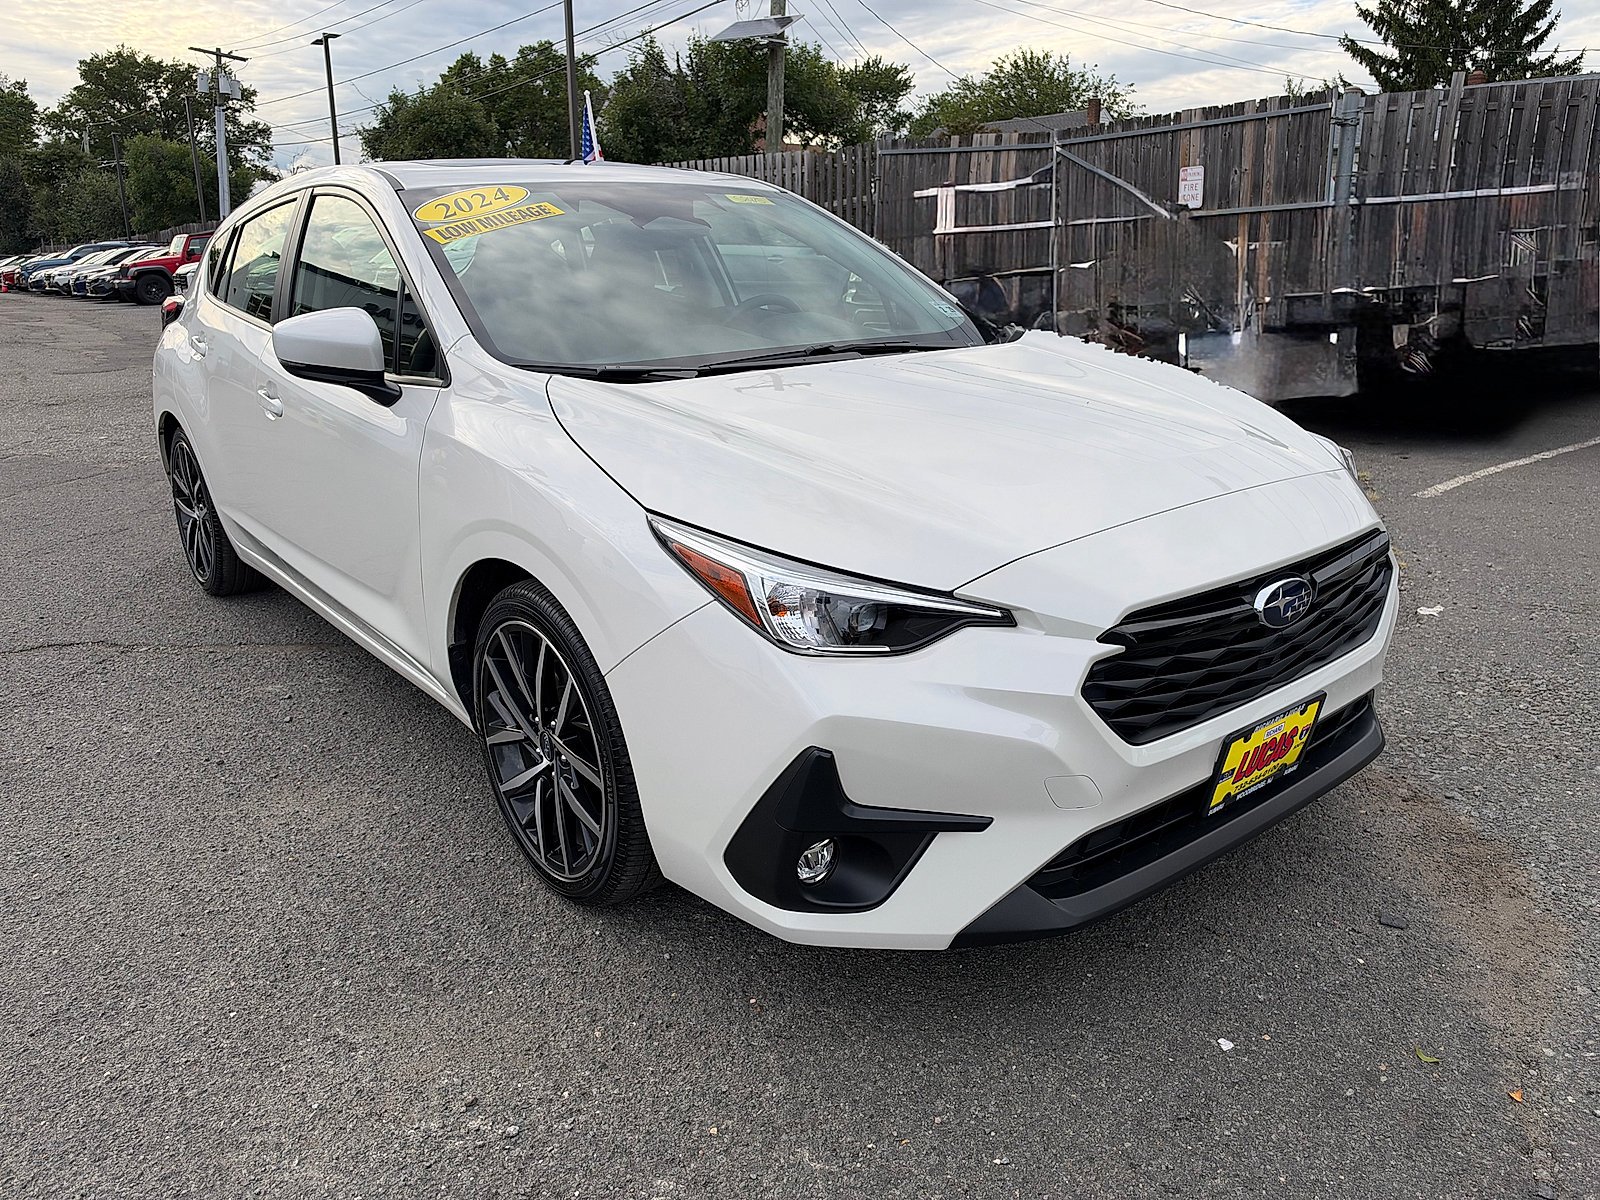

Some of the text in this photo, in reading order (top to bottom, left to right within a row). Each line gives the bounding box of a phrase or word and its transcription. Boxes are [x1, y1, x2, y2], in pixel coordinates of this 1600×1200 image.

[434, 187, 511, 220] 2024
[435, 203, 552, 241] LOW MILEAGE
[1231, 725, 1299, 786] LUCAS
